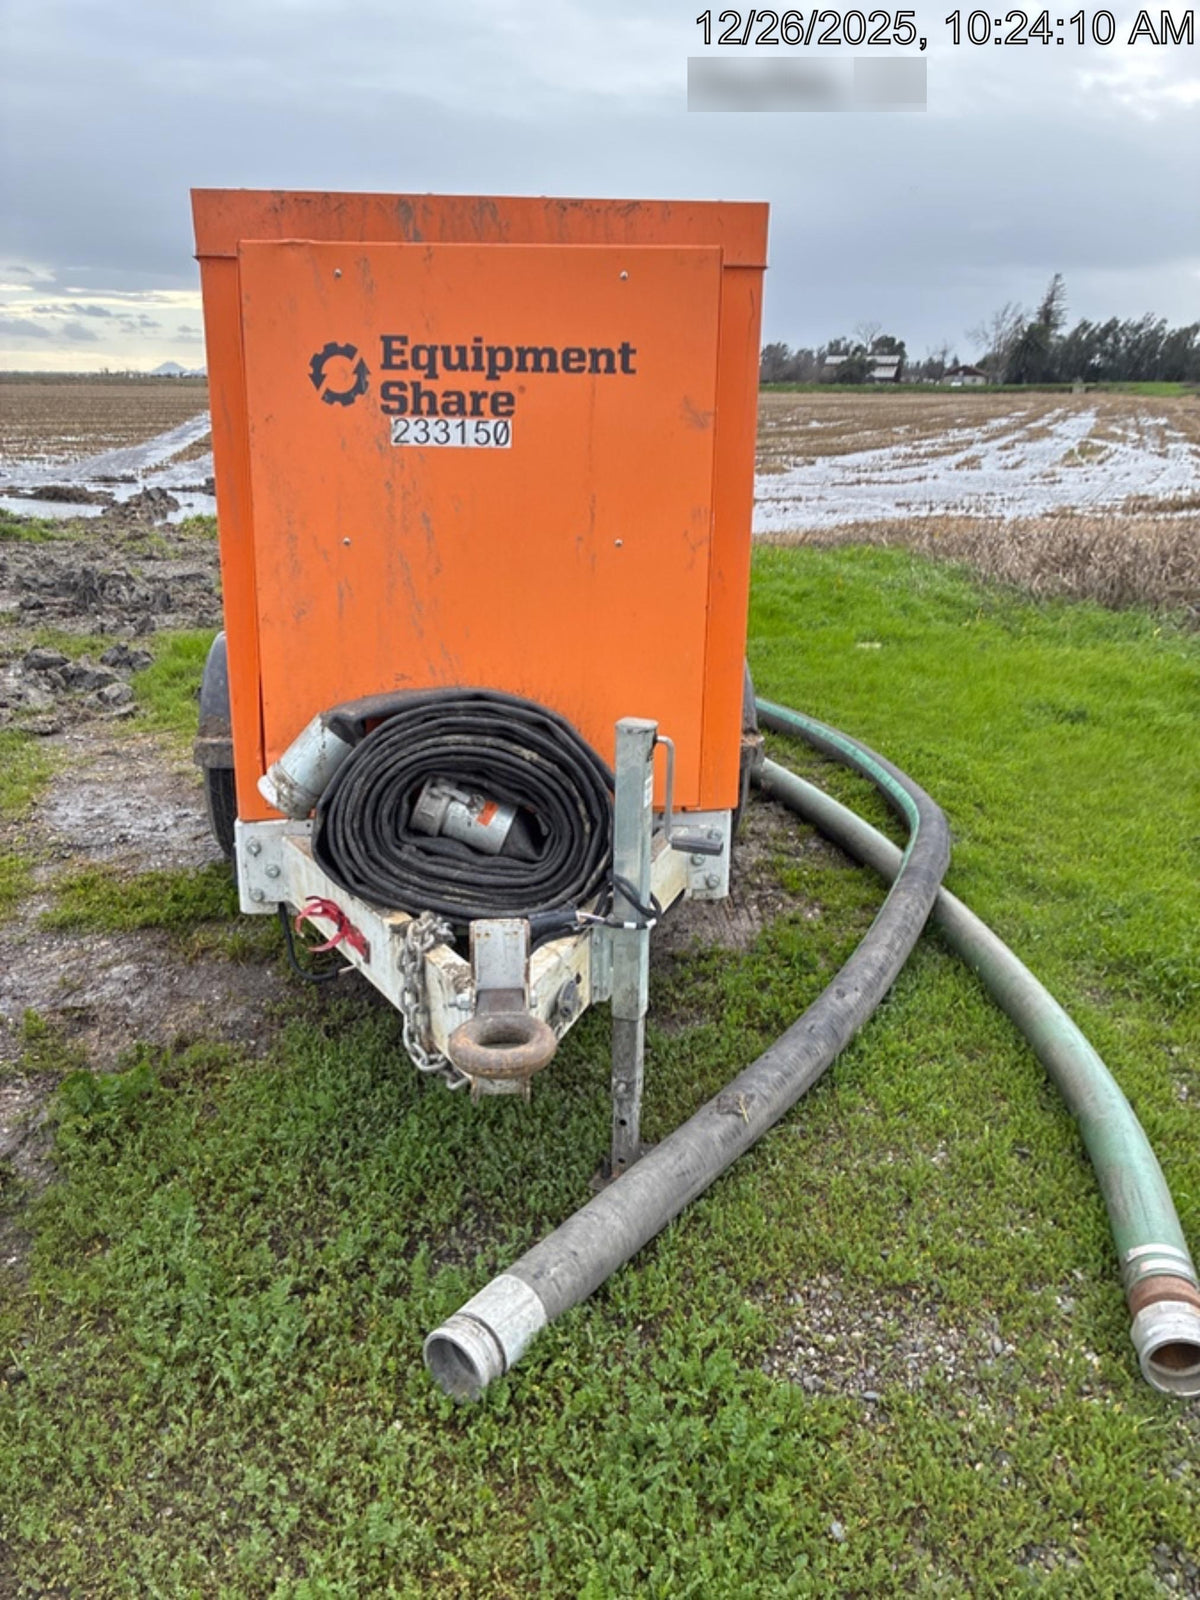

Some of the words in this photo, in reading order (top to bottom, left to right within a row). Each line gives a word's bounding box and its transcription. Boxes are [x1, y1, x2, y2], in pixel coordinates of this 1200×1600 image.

[380, 335, 637, 381] Equipment
[380, 380, 516, 417] Share
[393, 418, 510, 446] 233150
